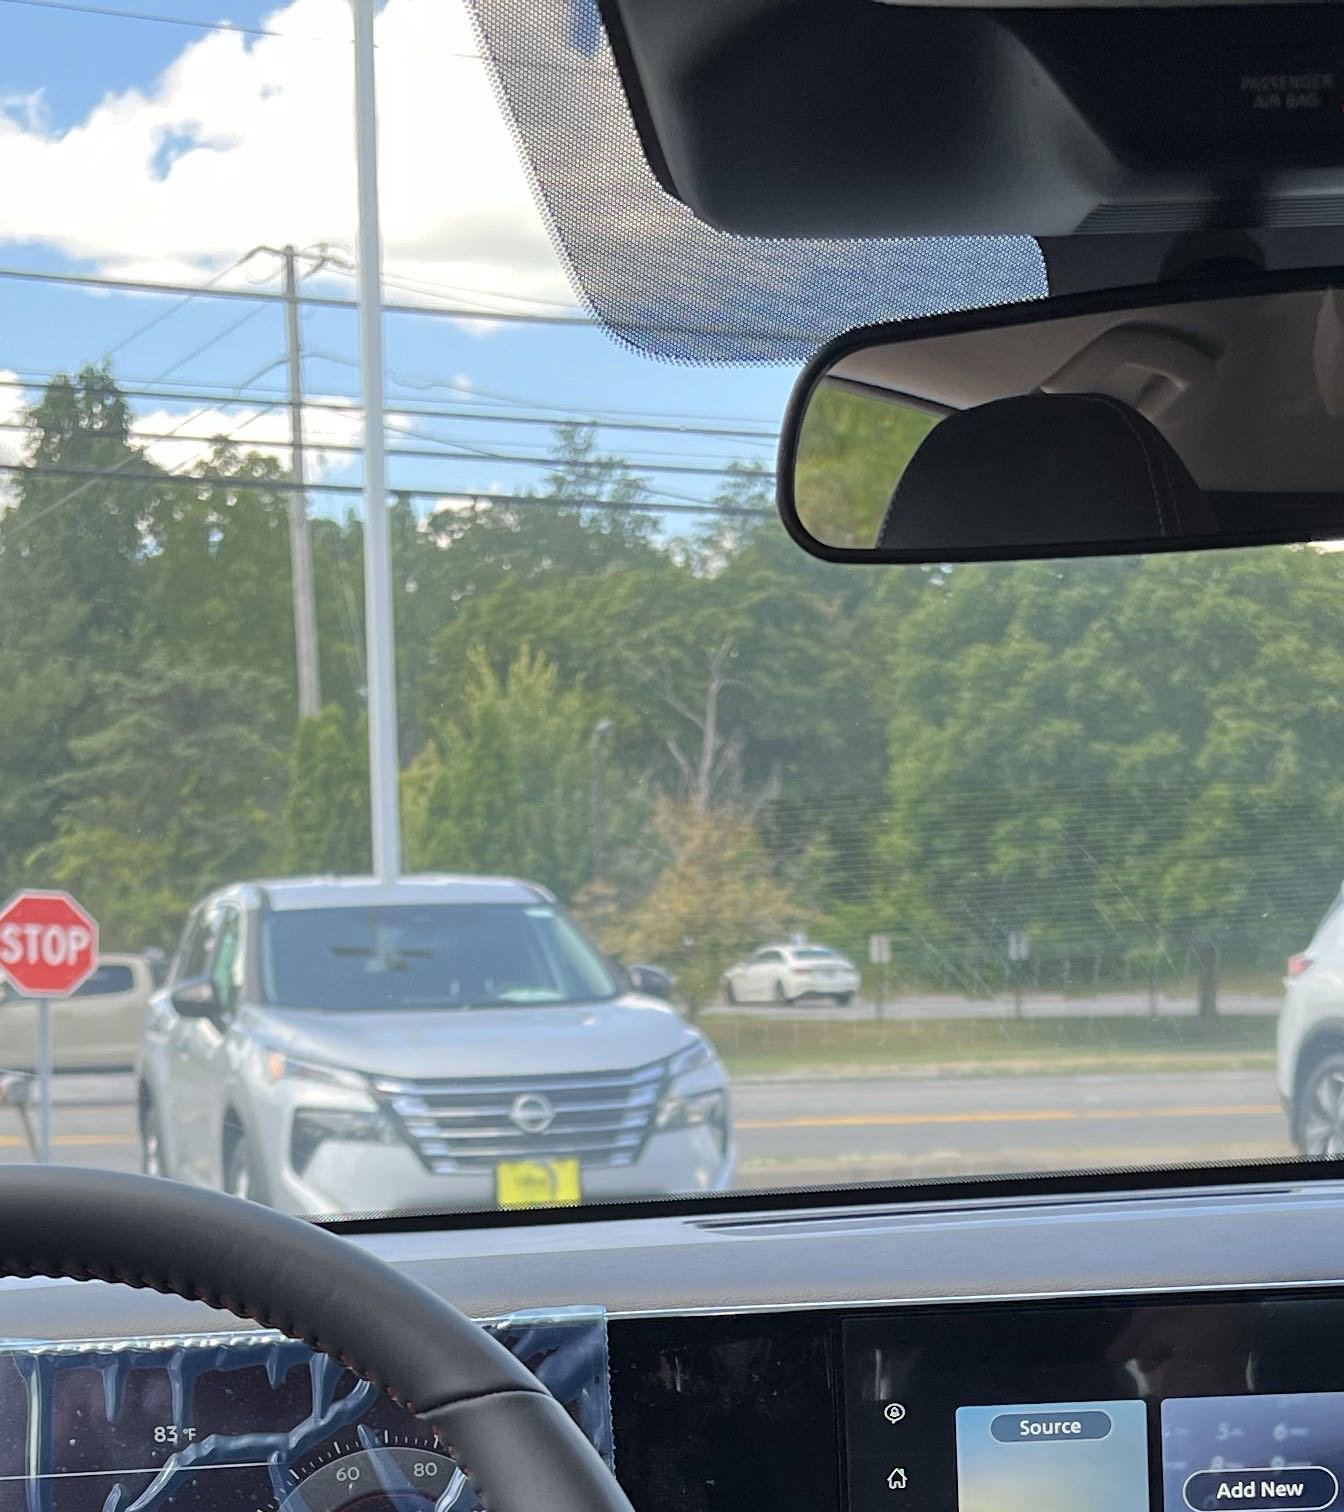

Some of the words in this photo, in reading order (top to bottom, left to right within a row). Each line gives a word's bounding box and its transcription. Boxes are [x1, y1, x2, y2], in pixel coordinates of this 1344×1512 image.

[153, 1425, 178, 1443] 83
[1019, 1418, 1082, 1436] Source
[335, 1465, 361, 1482] 60
[413, 1461, 438, 1478] 80
[1216, 1481, 1257, 1500] Add
[1261, 1481, 1304, 1498] New
